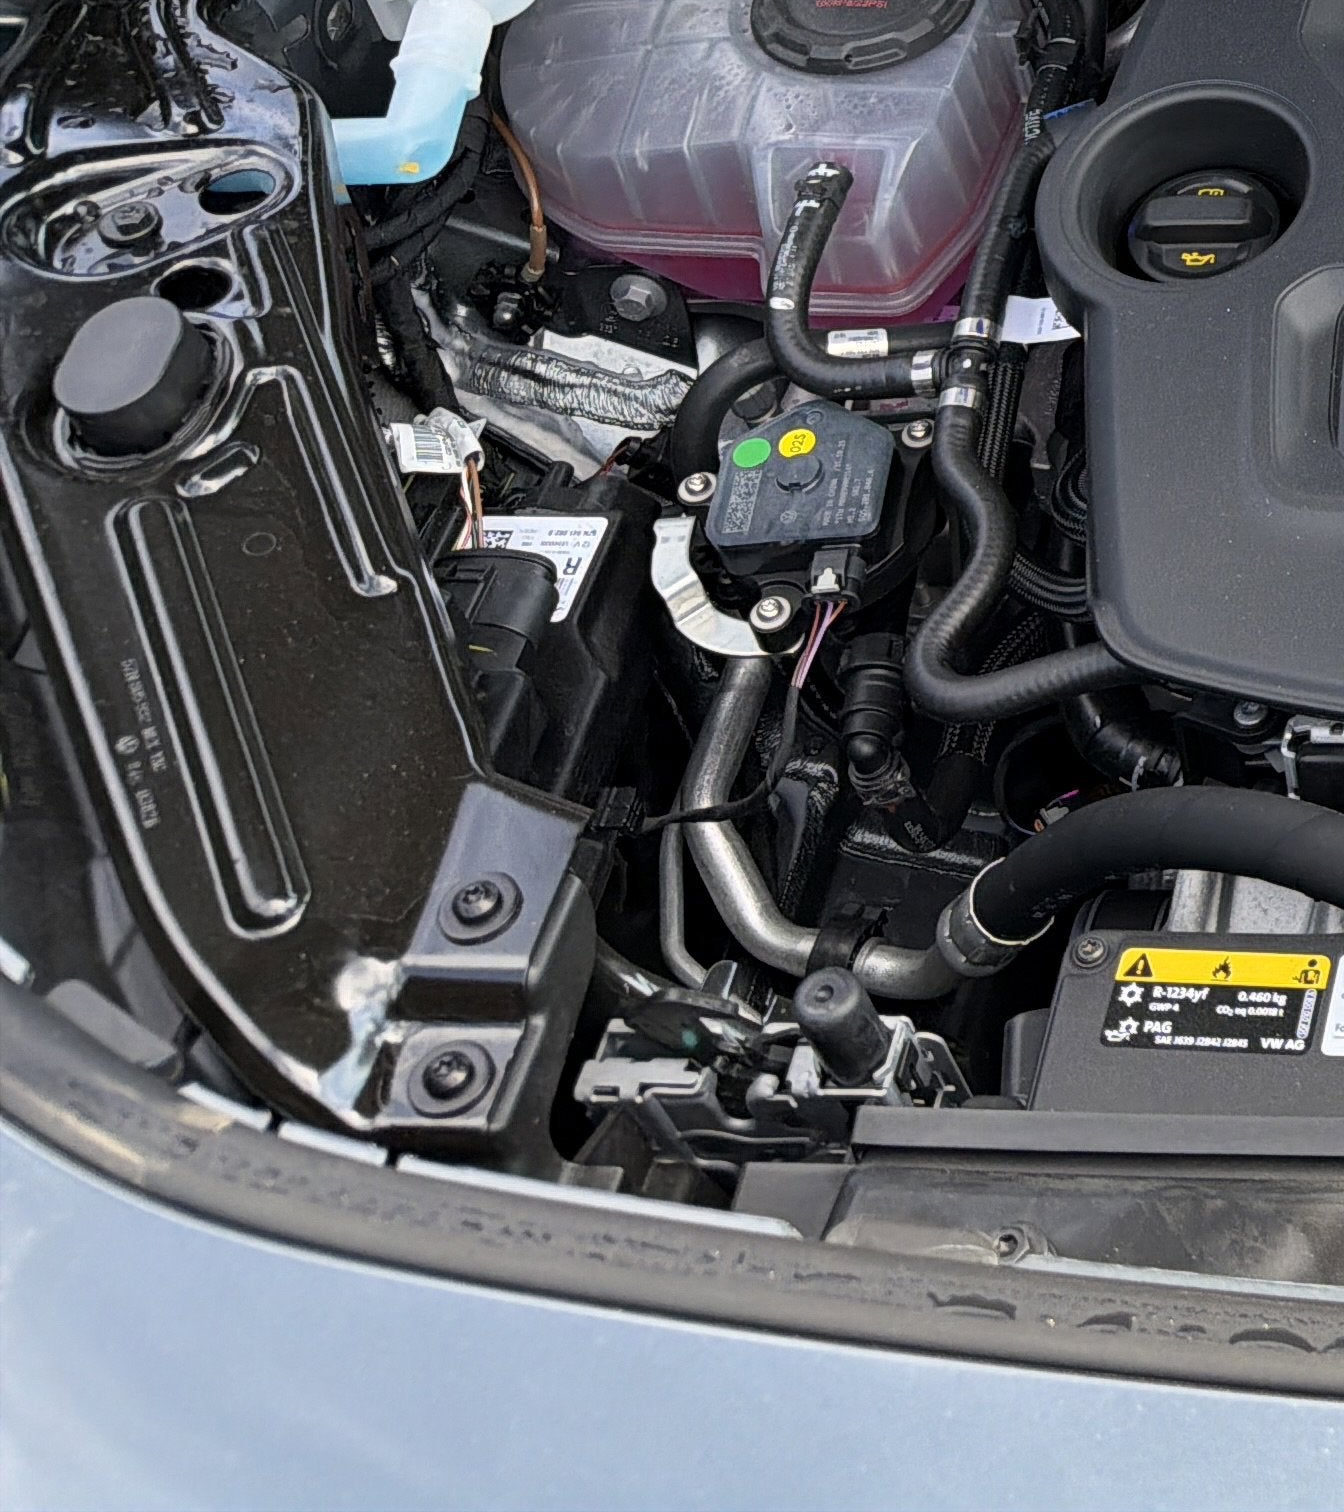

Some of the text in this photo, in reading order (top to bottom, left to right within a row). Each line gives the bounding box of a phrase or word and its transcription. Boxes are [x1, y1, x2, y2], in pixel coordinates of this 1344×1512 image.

[1152, 985, 1287, 1007] R-1234yf 0.460 kg
[1143, 1020, 1172, 1034] PAG
[1153, 1035, 1172, 1045] SAE
[1260, 1037, 1284, 1049] VW
[1284, 1038, 1306, 1050] AG
